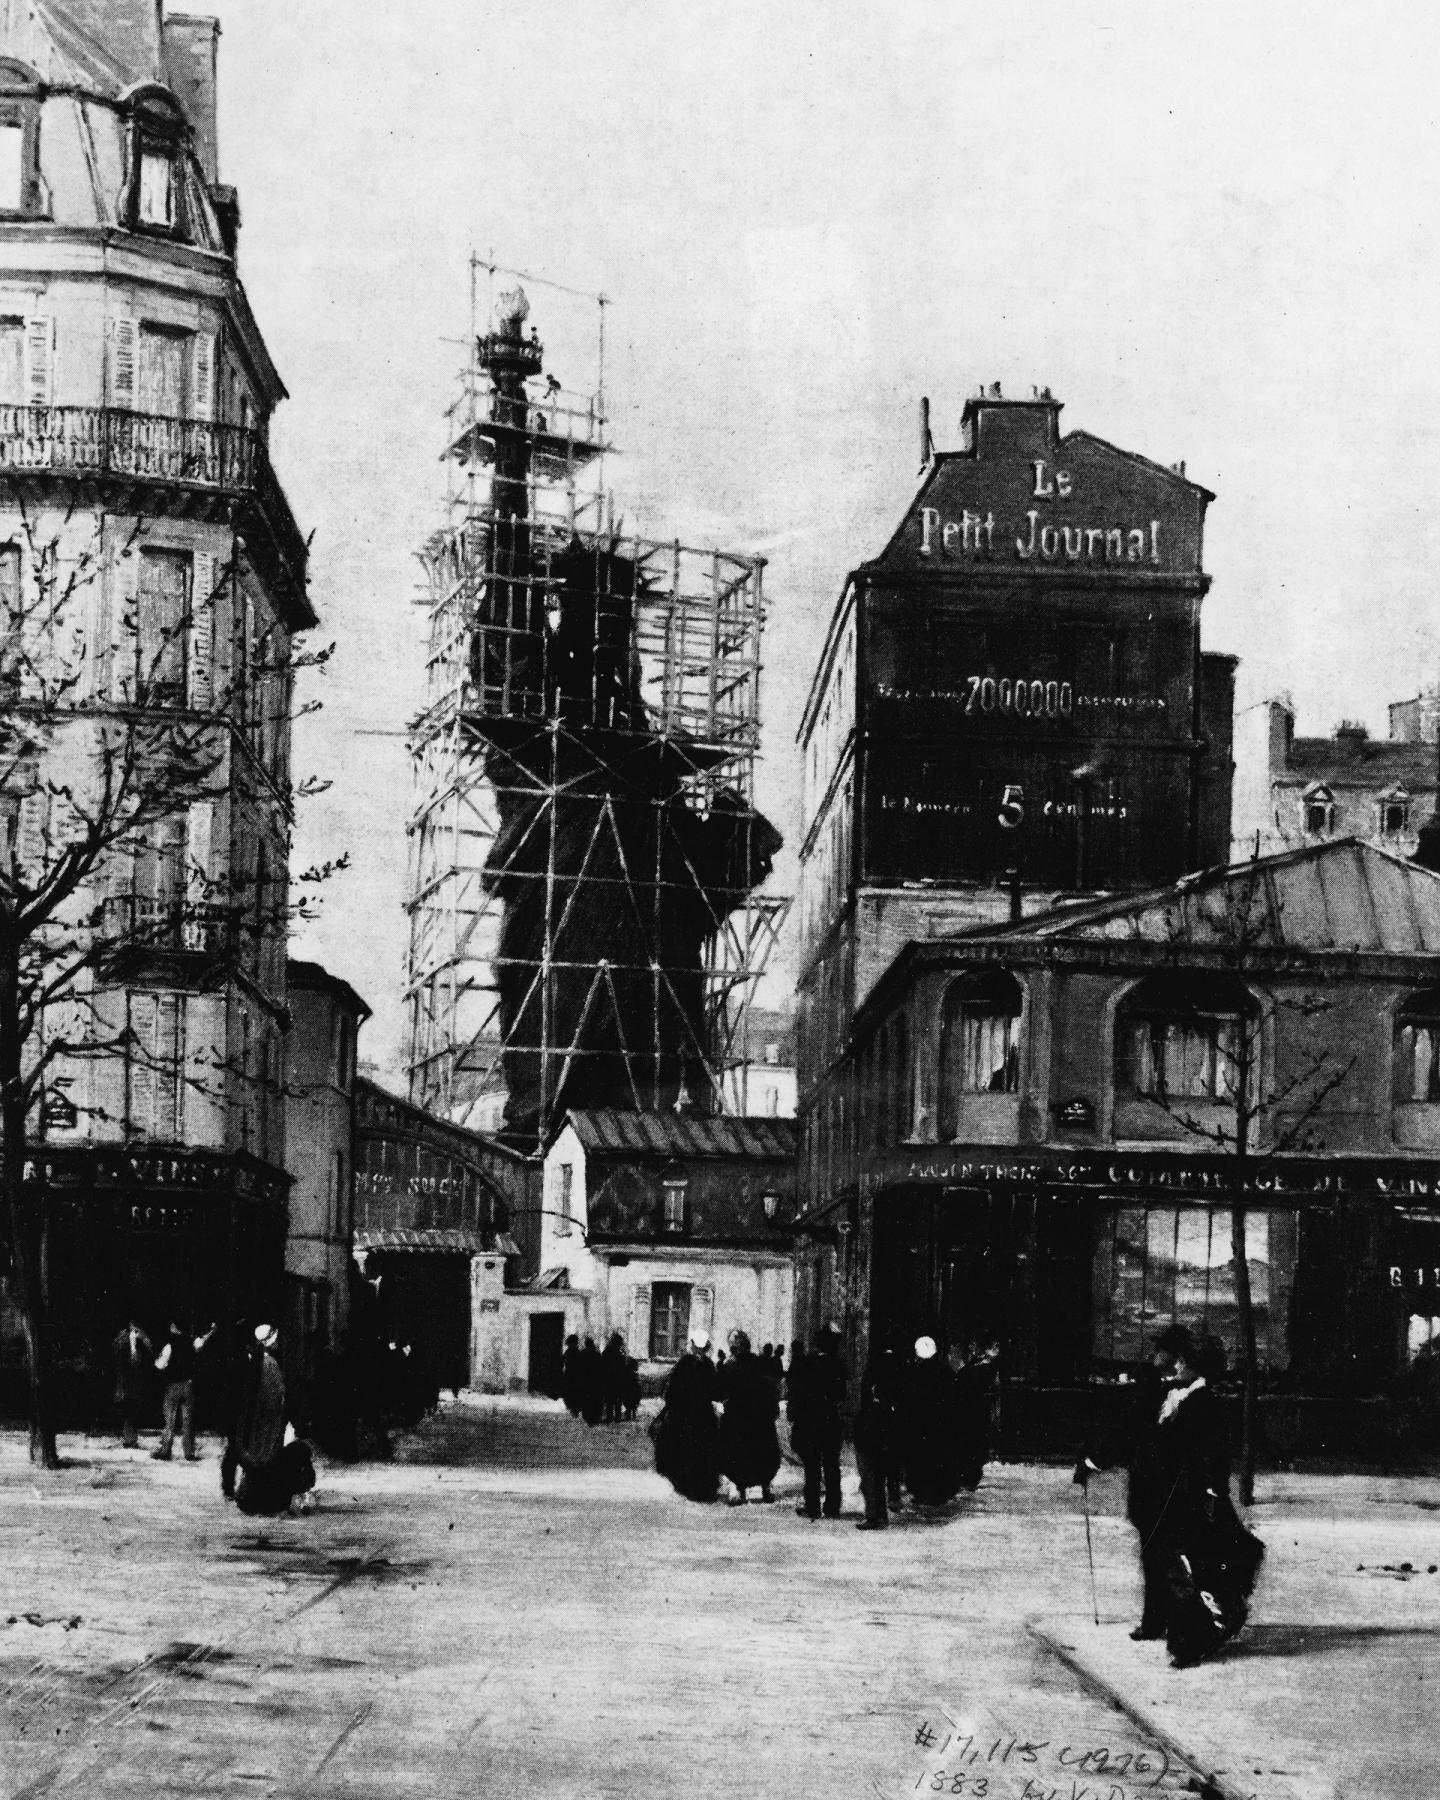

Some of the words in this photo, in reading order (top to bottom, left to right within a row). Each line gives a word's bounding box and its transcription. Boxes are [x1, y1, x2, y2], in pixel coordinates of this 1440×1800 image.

[1033, 459, 1072, 498] Le
[920, 507, 995, 555] Petit
[1016, 510, 1161, 564] Journal
[998, 784, 1025, 829] 5
[915, 1769, 988, 1798] 1883
